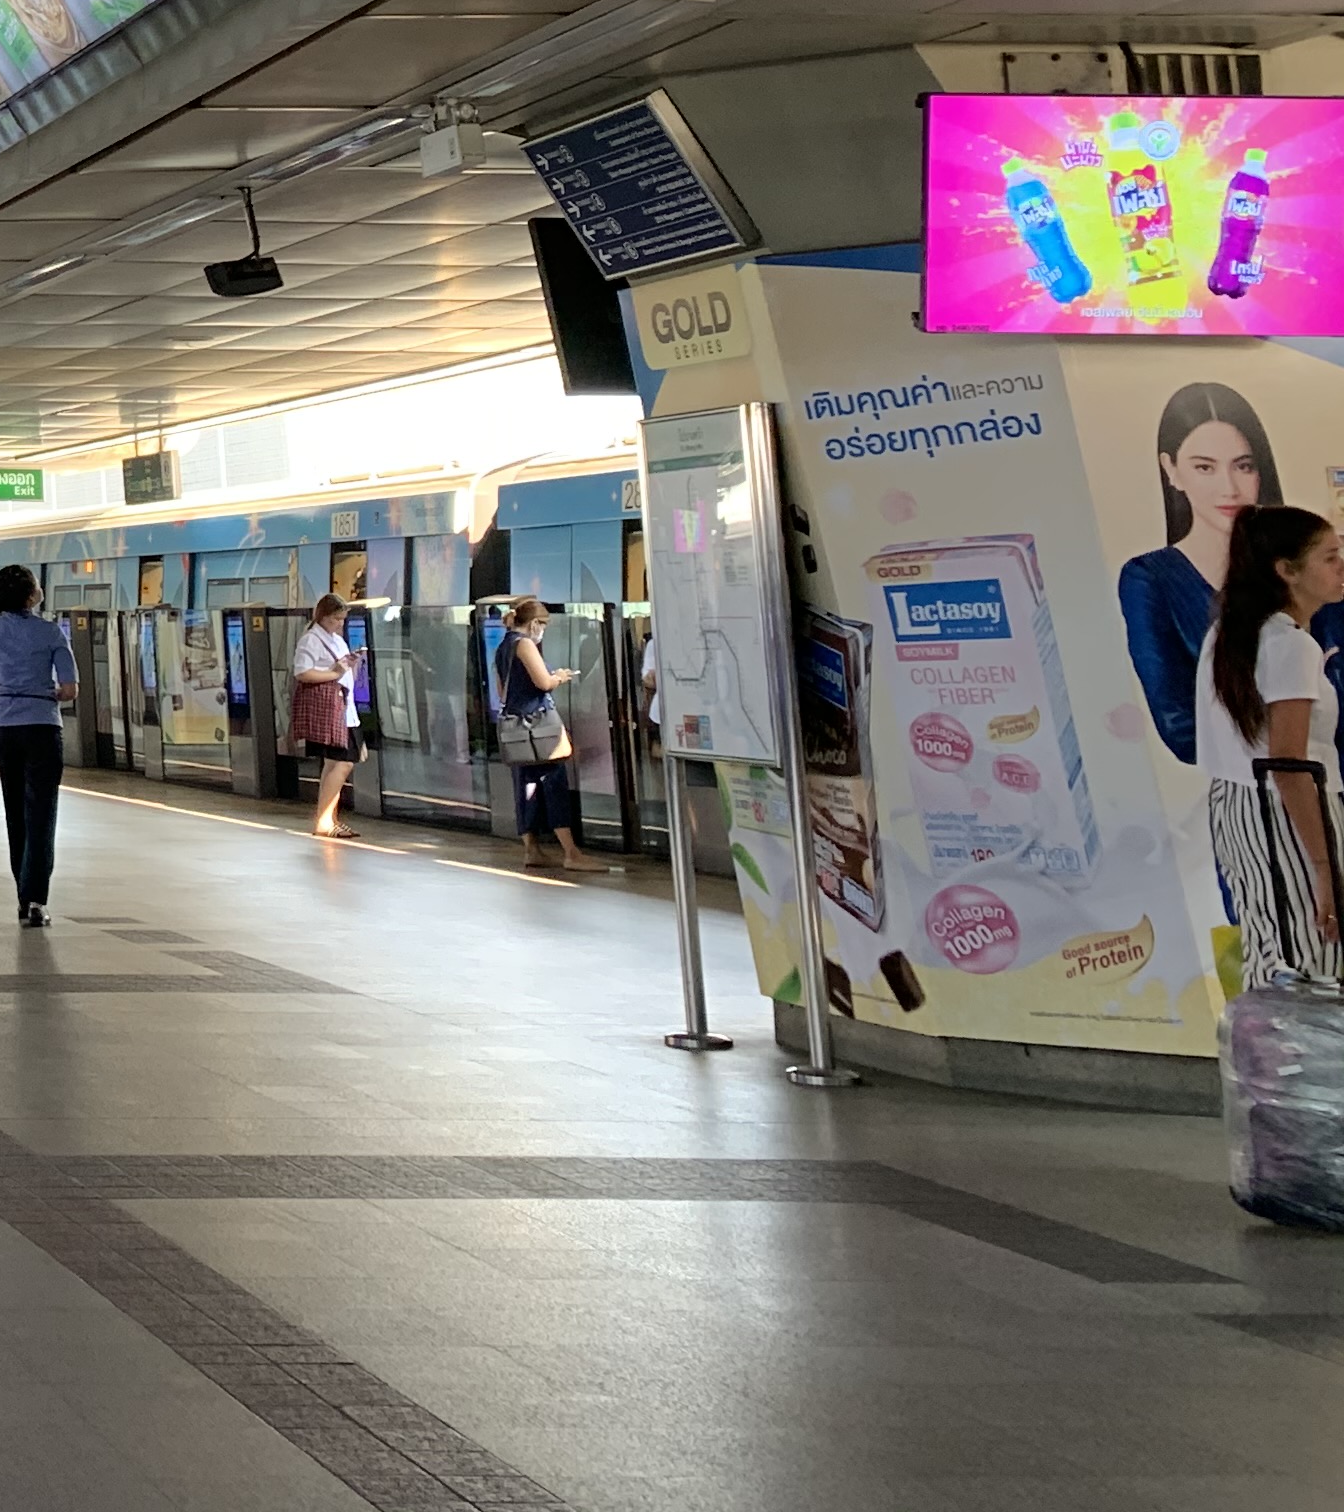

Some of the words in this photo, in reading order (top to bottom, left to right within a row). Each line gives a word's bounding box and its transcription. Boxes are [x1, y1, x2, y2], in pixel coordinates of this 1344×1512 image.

[651, 290, 733, 345] GOLD
[674, 339, 724, 360] SERIES
[824, 409, 1043, 461] อร่อยทุกกล่อง
[13, 485, 36, 497] Exit
[333, 512, 357, 537] 1851
[876, 565, 922, 579] GOLD
[888, 590, 1001, 637] Lactasoy
[902, 646, 956, 658] SOYMILK
[910, 665, 1017, 686] COLLAGEN
[937, 687, 996, 706] FIBER
[914, 724, 970, 749] Collagen
[997, 720, 1035, 738] Protein
[931, 904, 1006, 938] Collagen
[1062, 944, 1093, 961] Good
[1093, 934, 1131, 953] source
[1065, 966, 1078, 980] of
[1078, 942, 1145, 976] Protein
